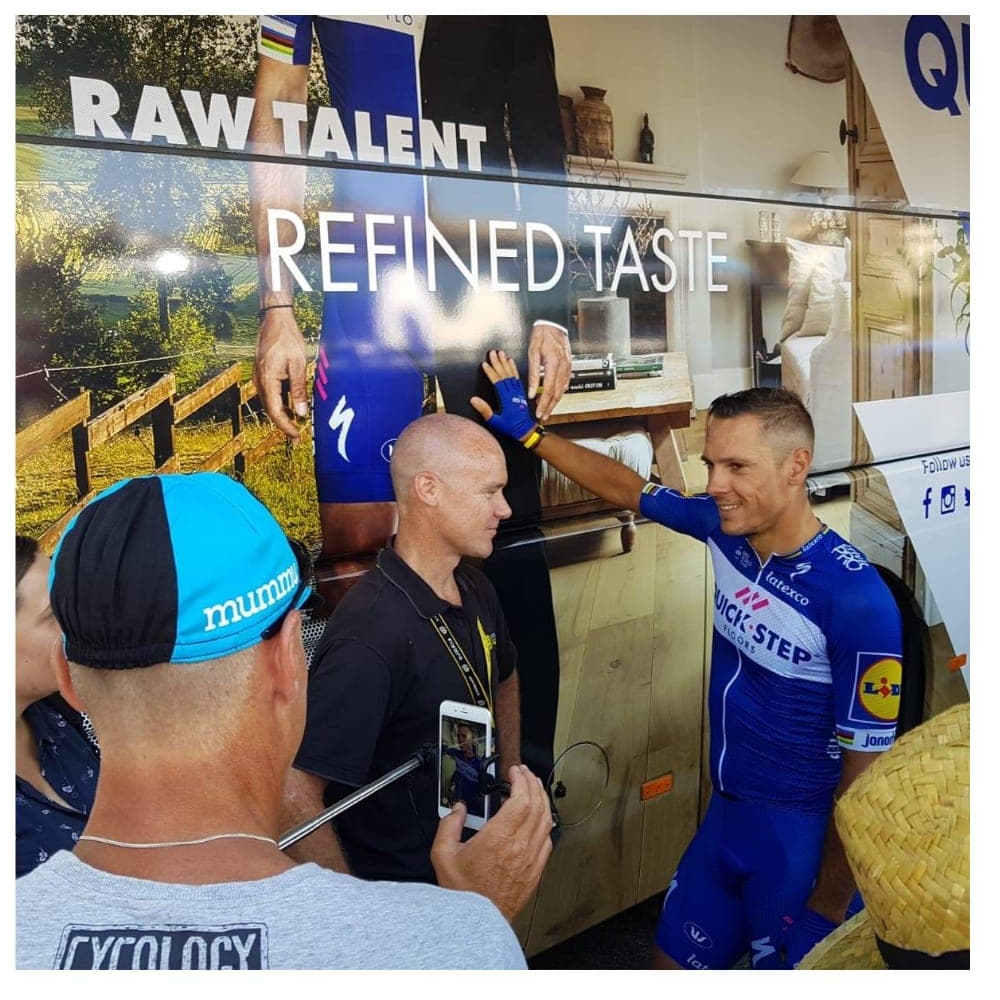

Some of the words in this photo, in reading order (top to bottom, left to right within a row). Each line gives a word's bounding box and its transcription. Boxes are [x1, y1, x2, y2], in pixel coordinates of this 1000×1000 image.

[69, 75, 257, 151] RAW
[271, 100, 488, 172] TALENT
[266, 207, 565, 292] REFINED
[583, 225, 729, 293] TASTE
[921, 455, 957, 475] Follow
[203, 562, 300, 632] mummu
[765, 571, 810, 606] latexco
